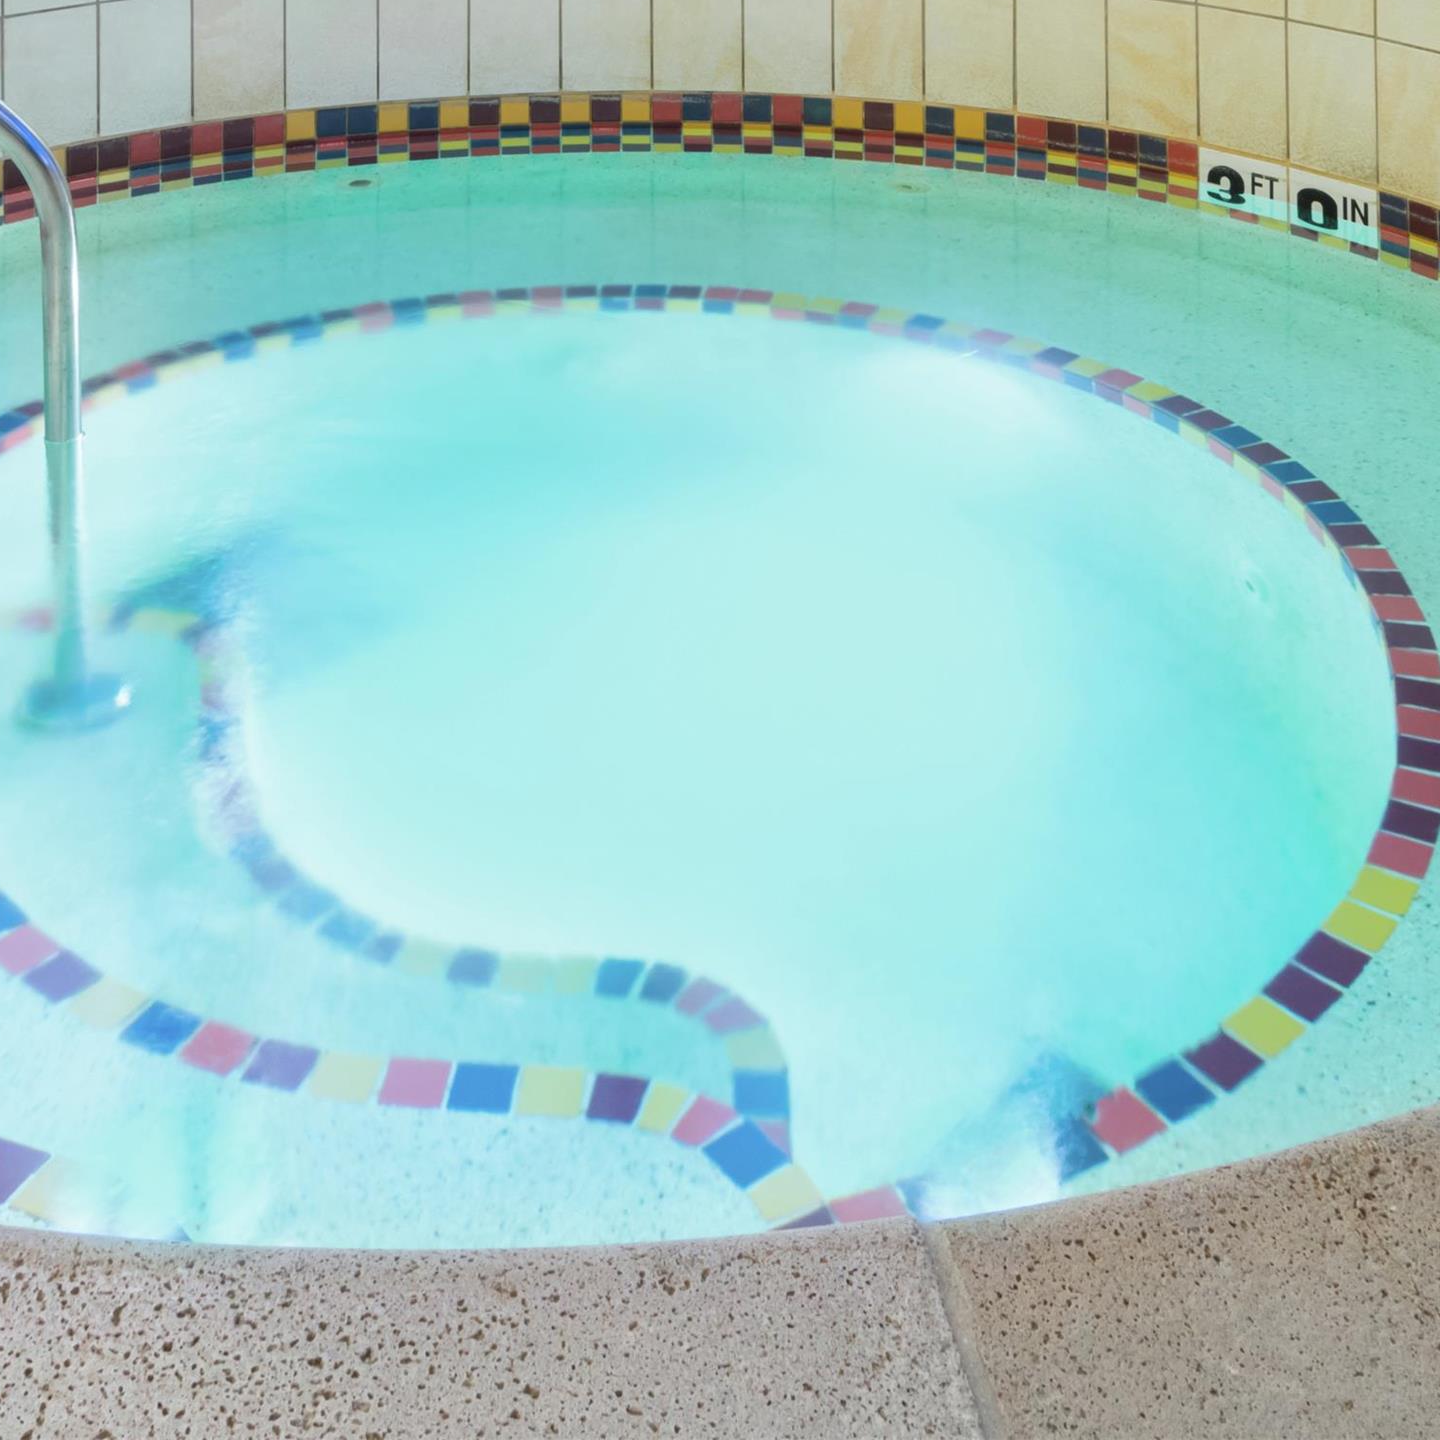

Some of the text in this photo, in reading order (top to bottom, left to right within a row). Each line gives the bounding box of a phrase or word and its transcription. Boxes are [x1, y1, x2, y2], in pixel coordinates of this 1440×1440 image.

[1207, 165, 1245, 204] 3
[1251, 172, 1279, 200] FT
[1343, 196, 1369, 227] IN
